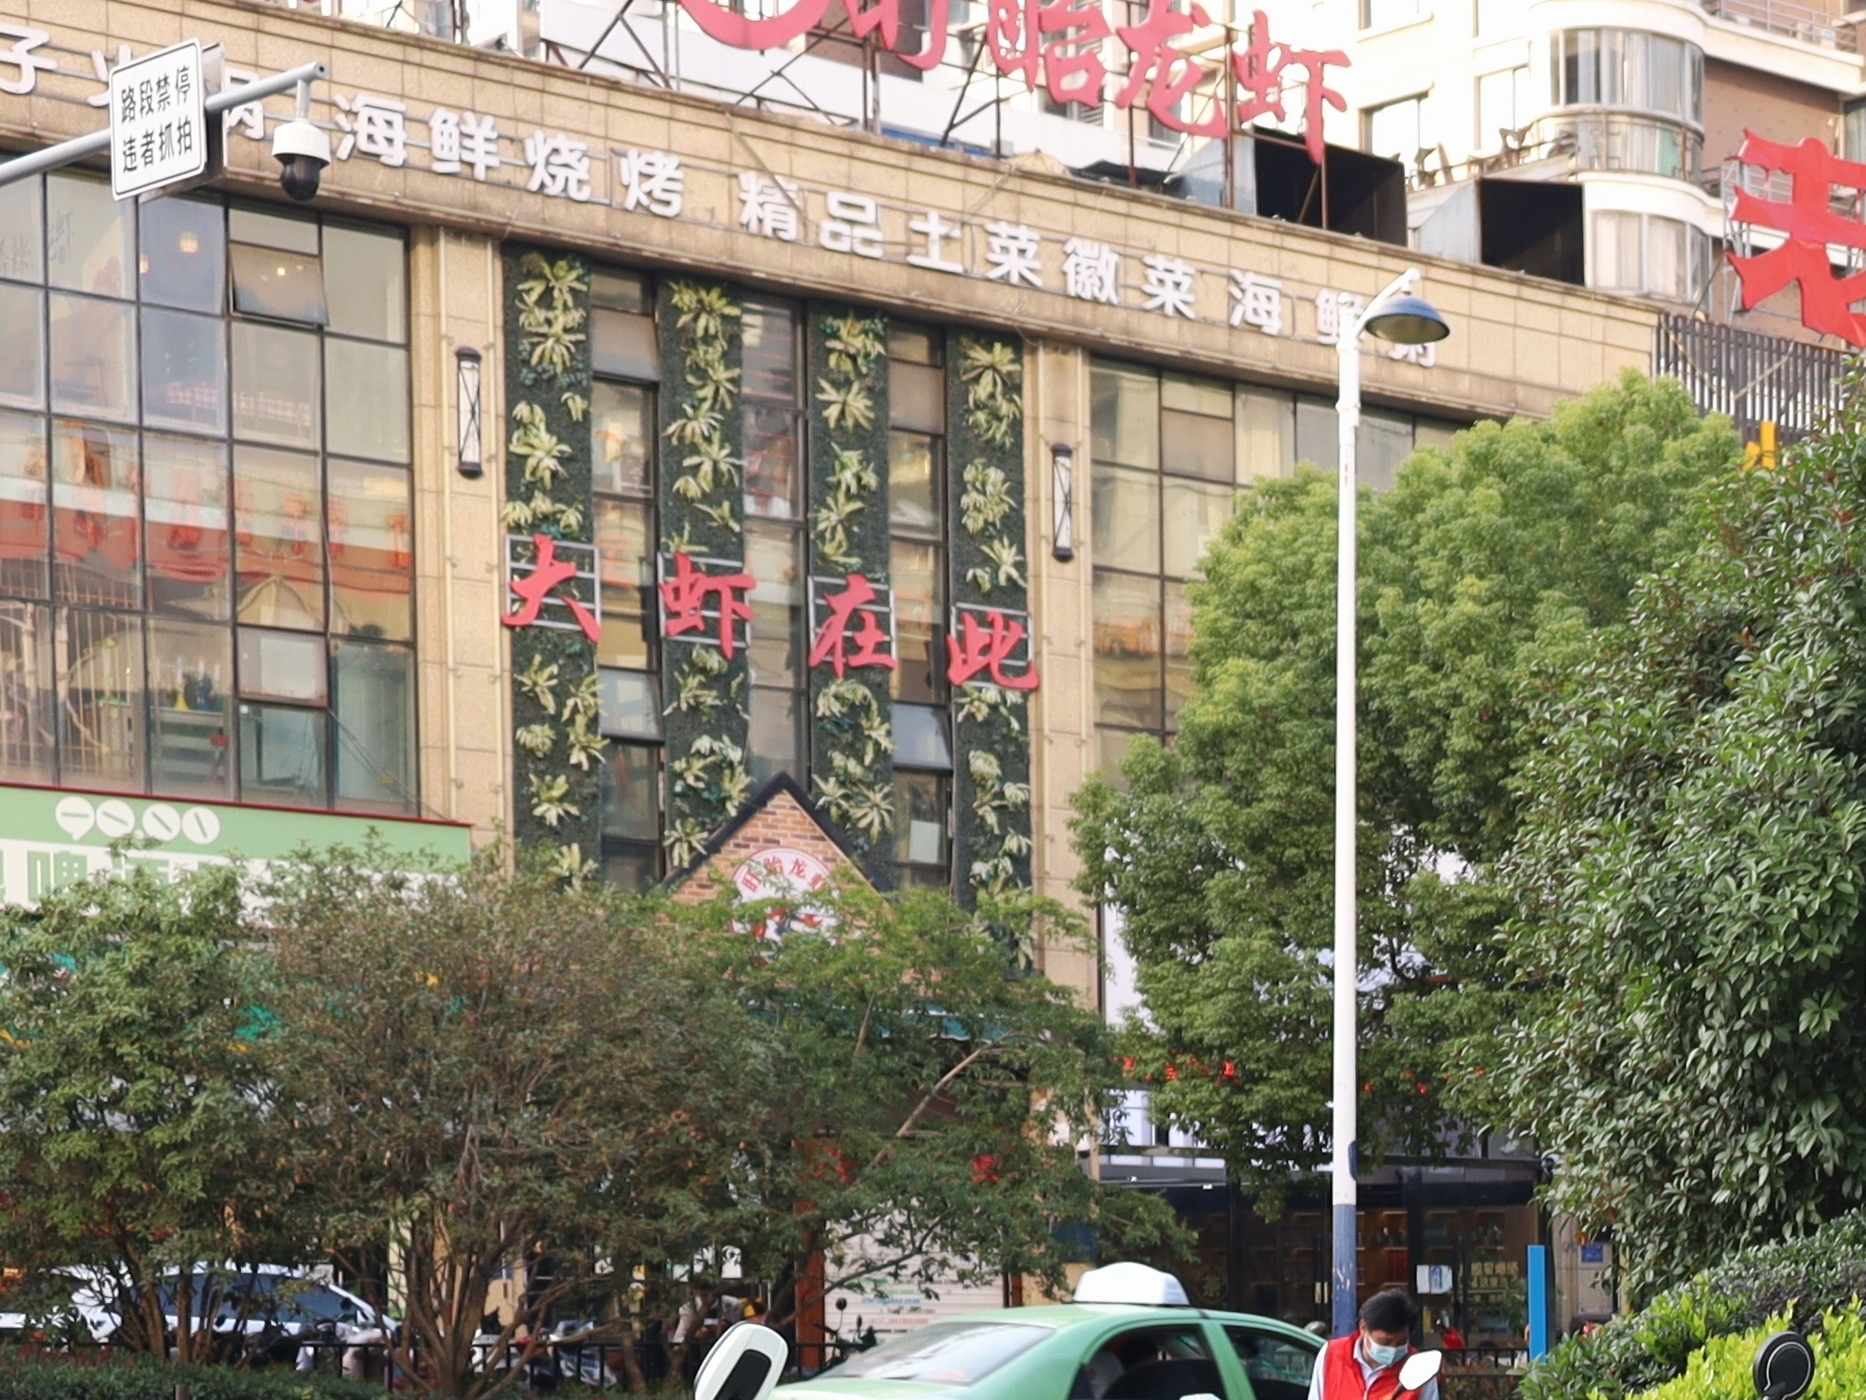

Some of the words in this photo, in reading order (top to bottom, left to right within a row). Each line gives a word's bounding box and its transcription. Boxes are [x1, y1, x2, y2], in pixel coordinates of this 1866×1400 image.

[121, 66, 191, 123] 路段禁停
[122, 116, 193, 174] 违者抓拍
[503, 534, 1040, 690] 大虾在此
